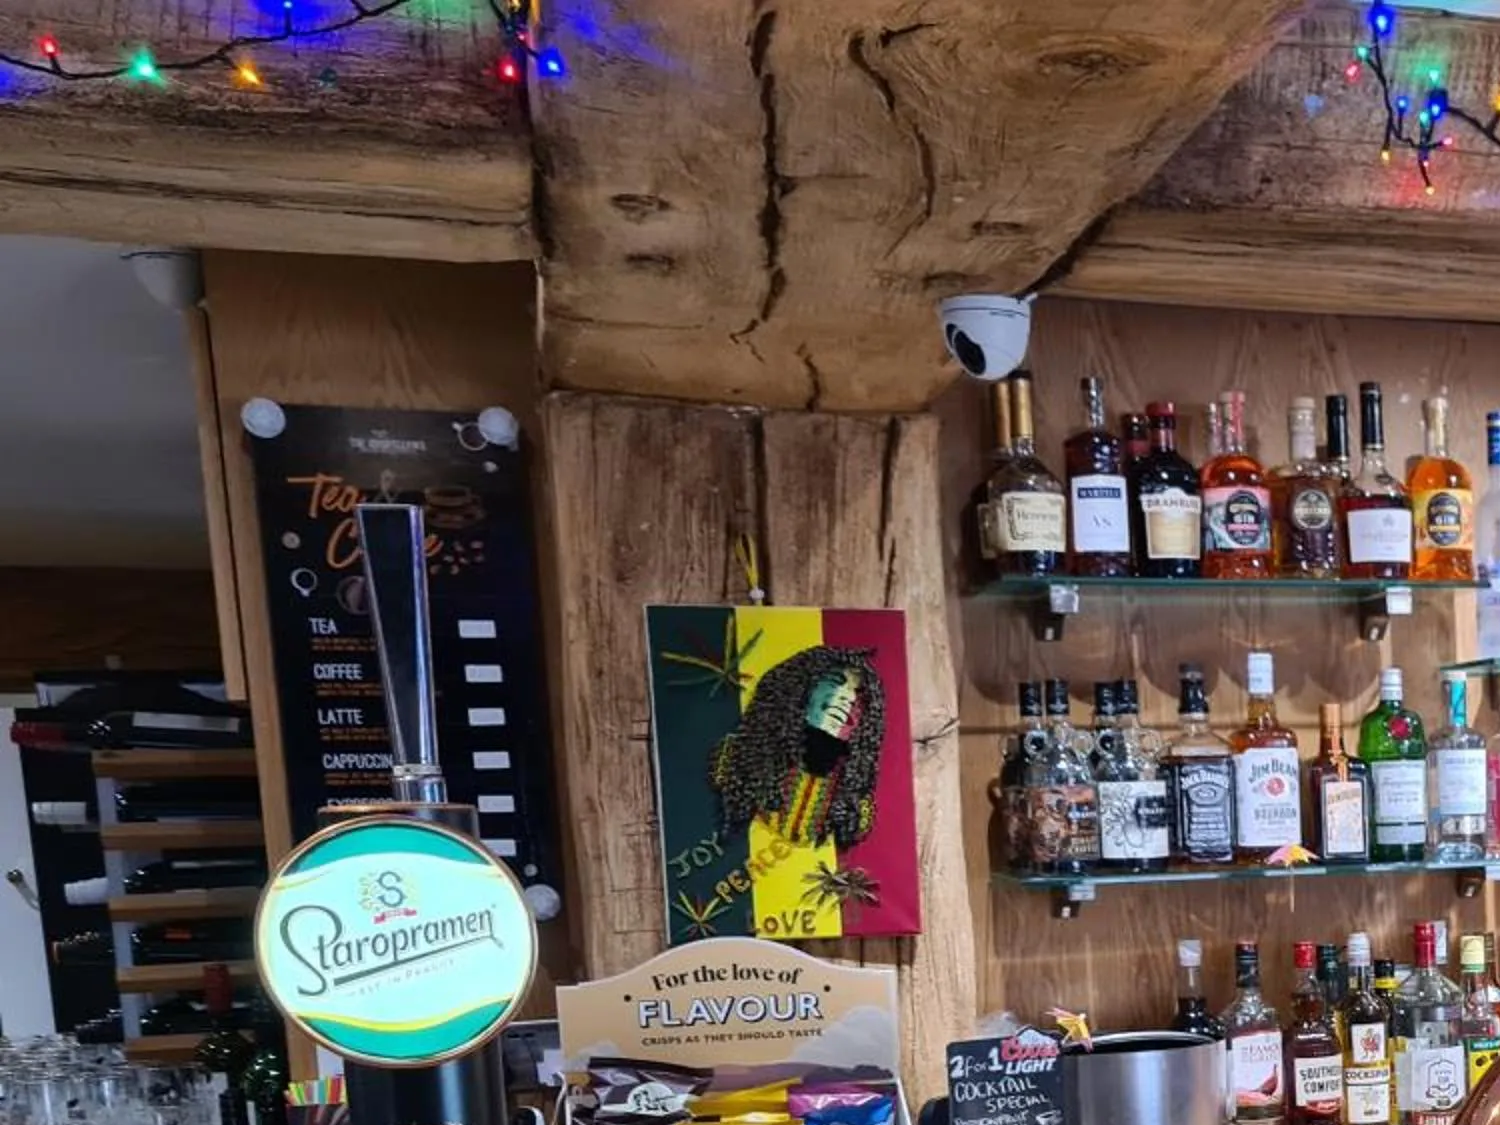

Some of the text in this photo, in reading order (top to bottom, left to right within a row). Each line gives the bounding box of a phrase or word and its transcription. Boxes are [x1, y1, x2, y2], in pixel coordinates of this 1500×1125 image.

[287, 473, 364, 518] Tea
[309, 617, 338, 635] TEA
[314, 662, 363, 681] COFFEE
[318, 709, 364, 726] LATTE
[323, 752, 394, 770] CAPPUCCIN
[668, 832, 724, 878] JOY
[716, 836, 794, 905] PEACE
[279, 902, 502, 997] Staropramen
[652, 963, 804, 992] For the love of
[638, 992, 825, 1029] FLAVOUR
[642, 1035, 682, 1047] CRISPS
[950, 1055, 964, 1078] 2
[987, 1047, 1003, 1072] 1
[1005, 1056, 1057, 1075] LIGHT
[954, 1077, 1039, 1102] COCKTAIL
[985, 1093, 1051, 1114] SPECIAL
